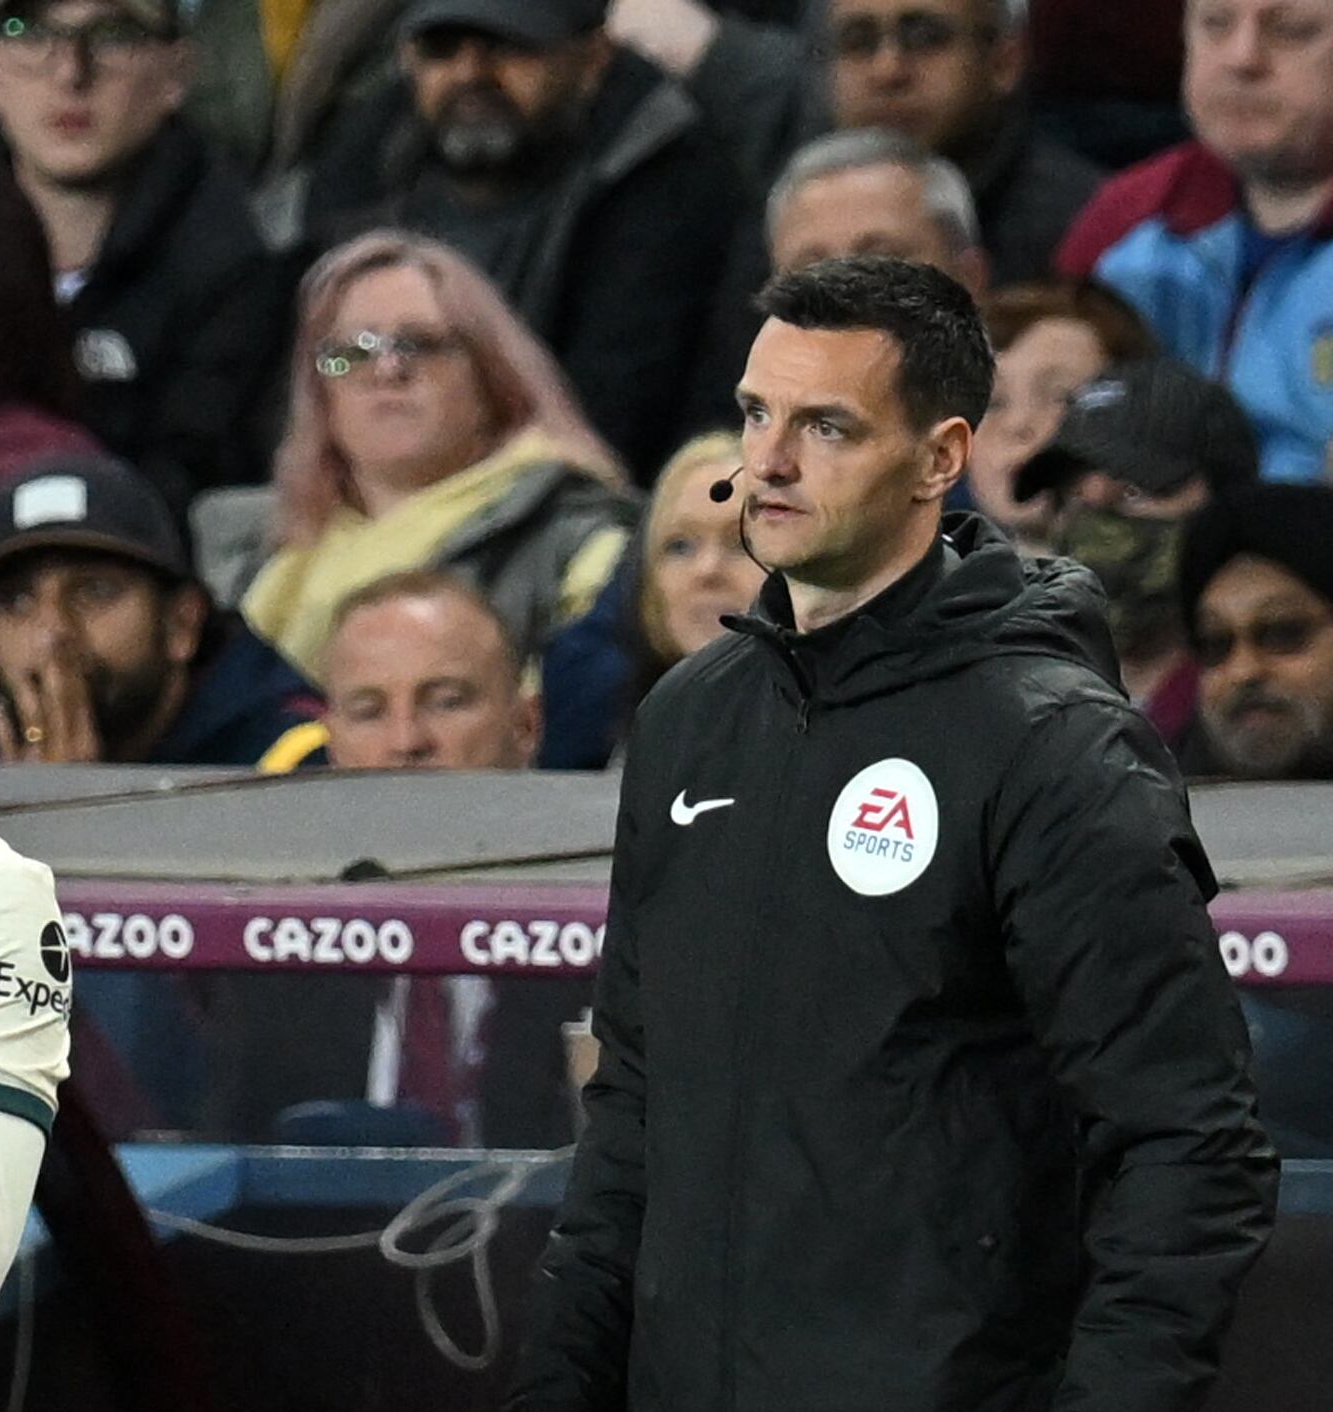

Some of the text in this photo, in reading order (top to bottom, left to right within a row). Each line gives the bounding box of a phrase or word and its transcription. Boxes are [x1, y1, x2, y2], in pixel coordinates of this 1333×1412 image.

[851, 787, 915, 841] EA
[842, 829, 915, 863] SPORTS
[242, 916, 415, 965] CAZOO
